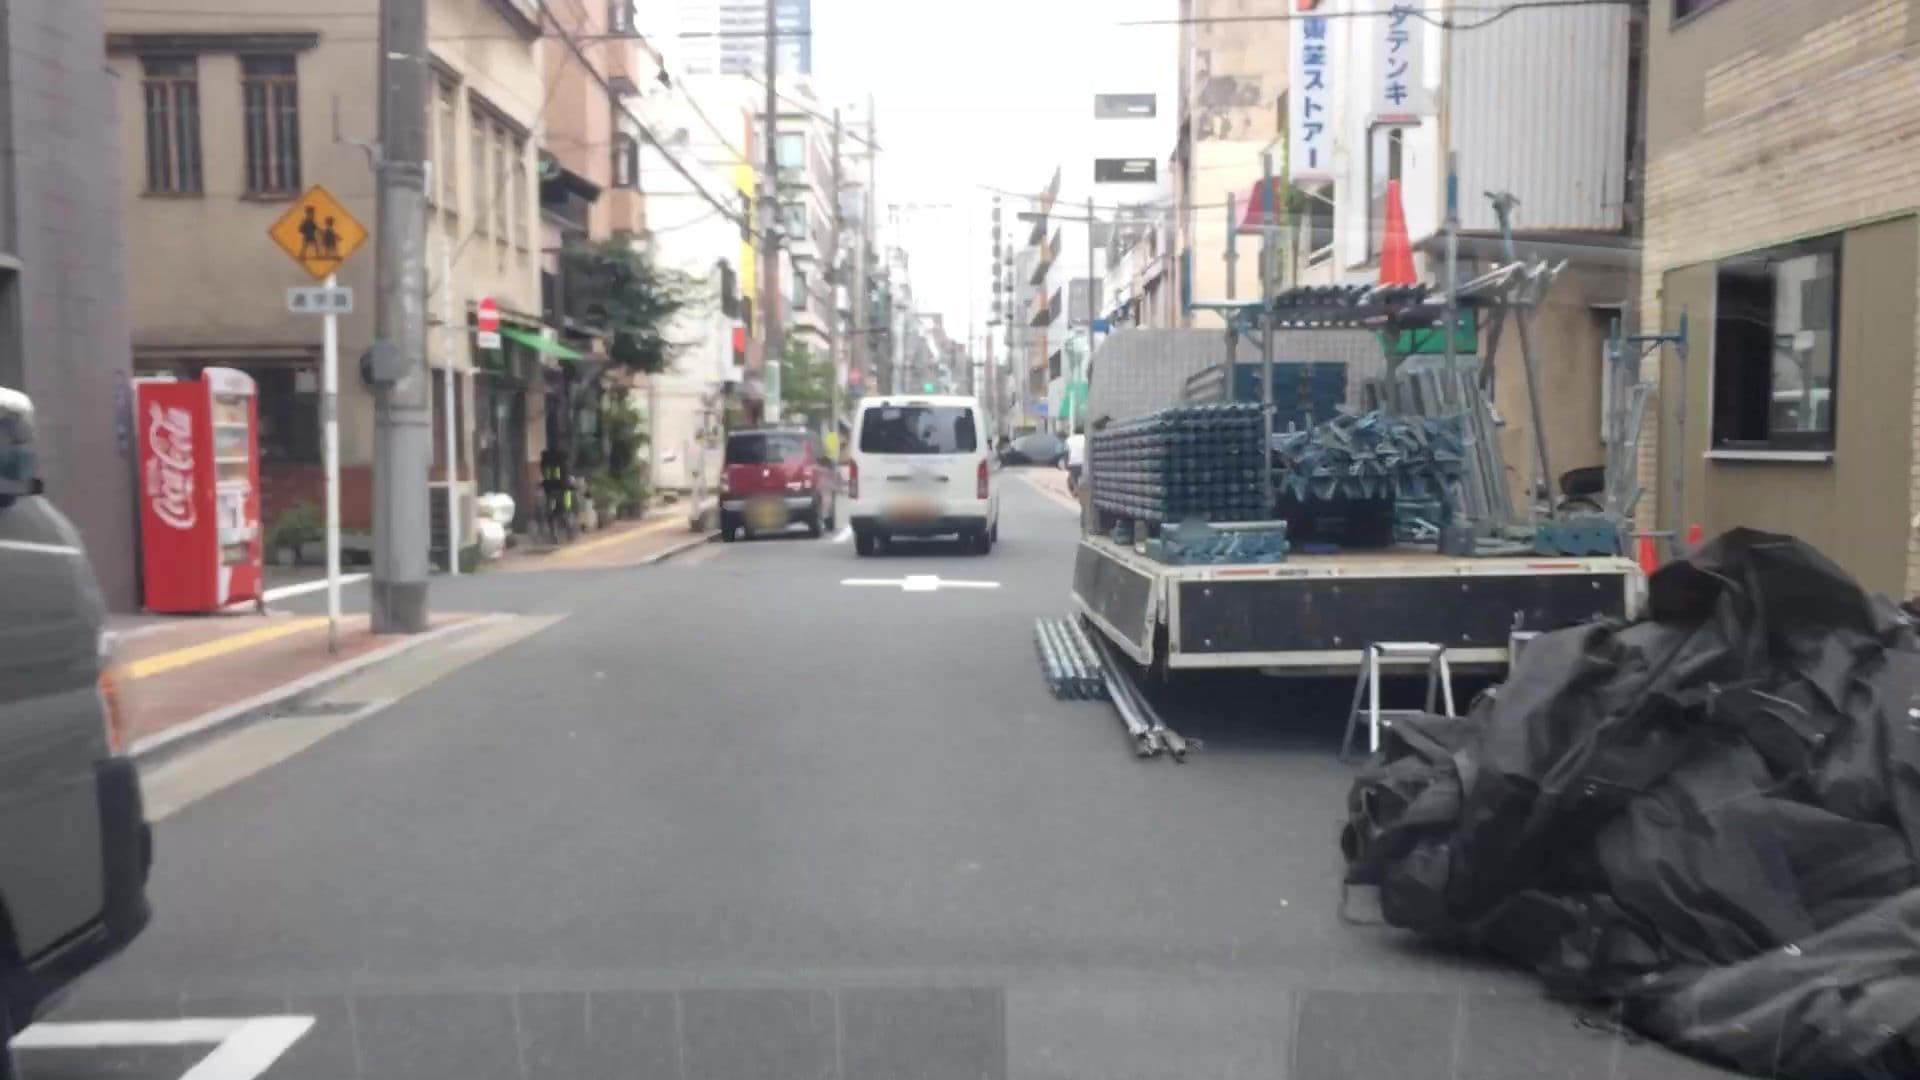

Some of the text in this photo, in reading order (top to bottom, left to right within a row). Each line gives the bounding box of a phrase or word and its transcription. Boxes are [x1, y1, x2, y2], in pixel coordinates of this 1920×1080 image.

[1302, 16, 1327, 169] 東芝ストアー
